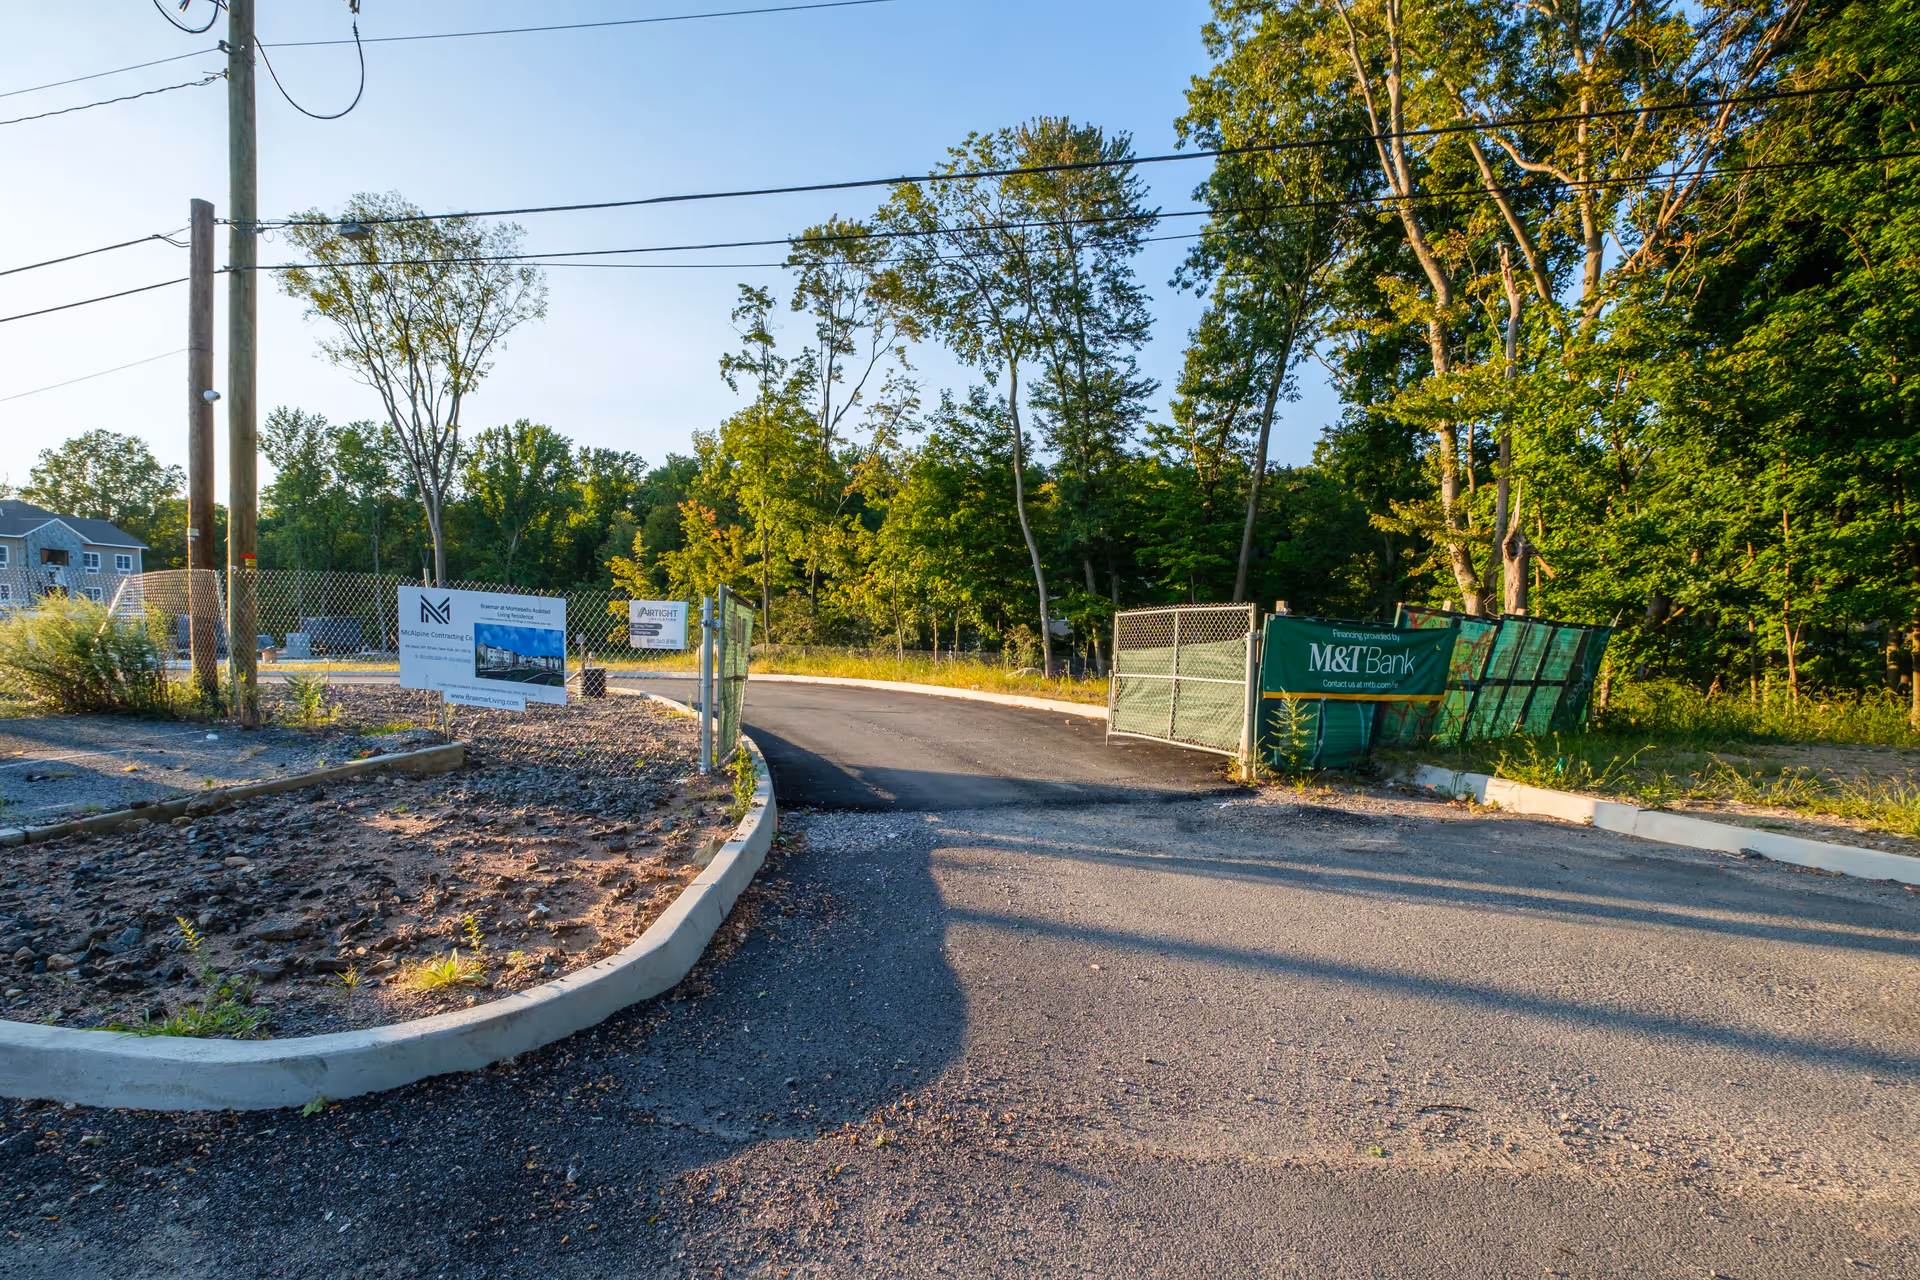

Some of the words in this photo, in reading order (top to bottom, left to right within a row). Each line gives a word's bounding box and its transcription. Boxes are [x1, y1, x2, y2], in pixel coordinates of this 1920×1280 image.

[505, 605, 532, 613] Montebello
[532, 607, 551, 615] Assisted
[637, 607, 678, 618] AIRTIGHT
[511, 612, 534, 620] Residence
[400, 629, 430, 638] McAlpine
[431, 631, 465, 641] Contracting
[1332, 628, 1364, 641] Financing
[1363, 631, 1391, 641] provided
[1391, 632, 1400, 643] by
[1308, 642, 1367, 673] M&T
[1365, 646, 1416, 674] Bank
[1323, 679, 1347, 688] Contact
[450, 692, 520, 707] www.BraemarLiving.com
